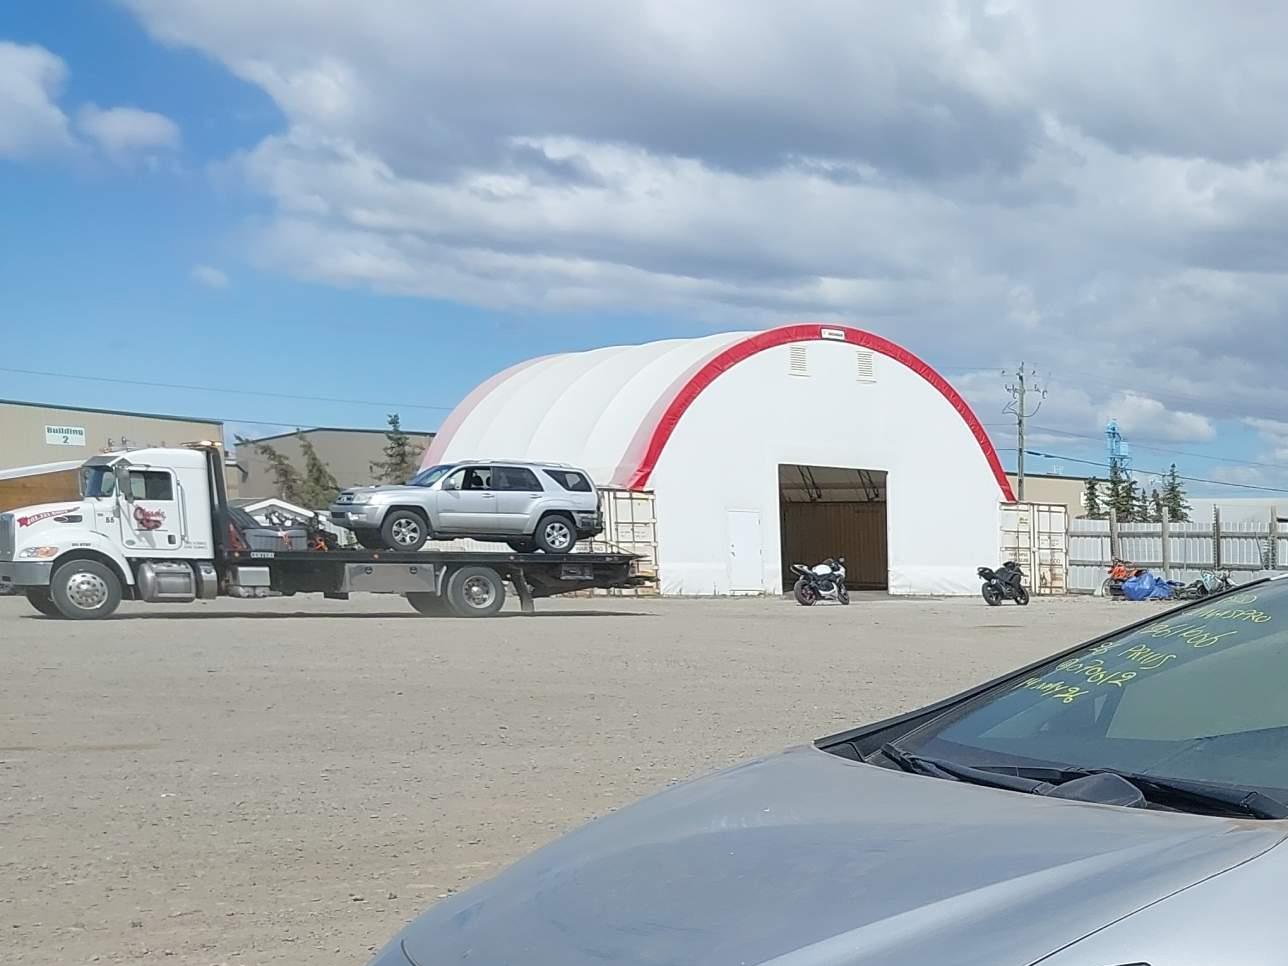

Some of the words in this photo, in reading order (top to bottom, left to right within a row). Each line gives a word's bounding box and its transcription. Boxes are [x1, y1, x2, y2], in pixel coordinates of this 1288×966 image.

[47, 426, 84, 436] Building
[62, 435, 69, 443] 2
[1118, 644, 1176, 670] PRIUS
